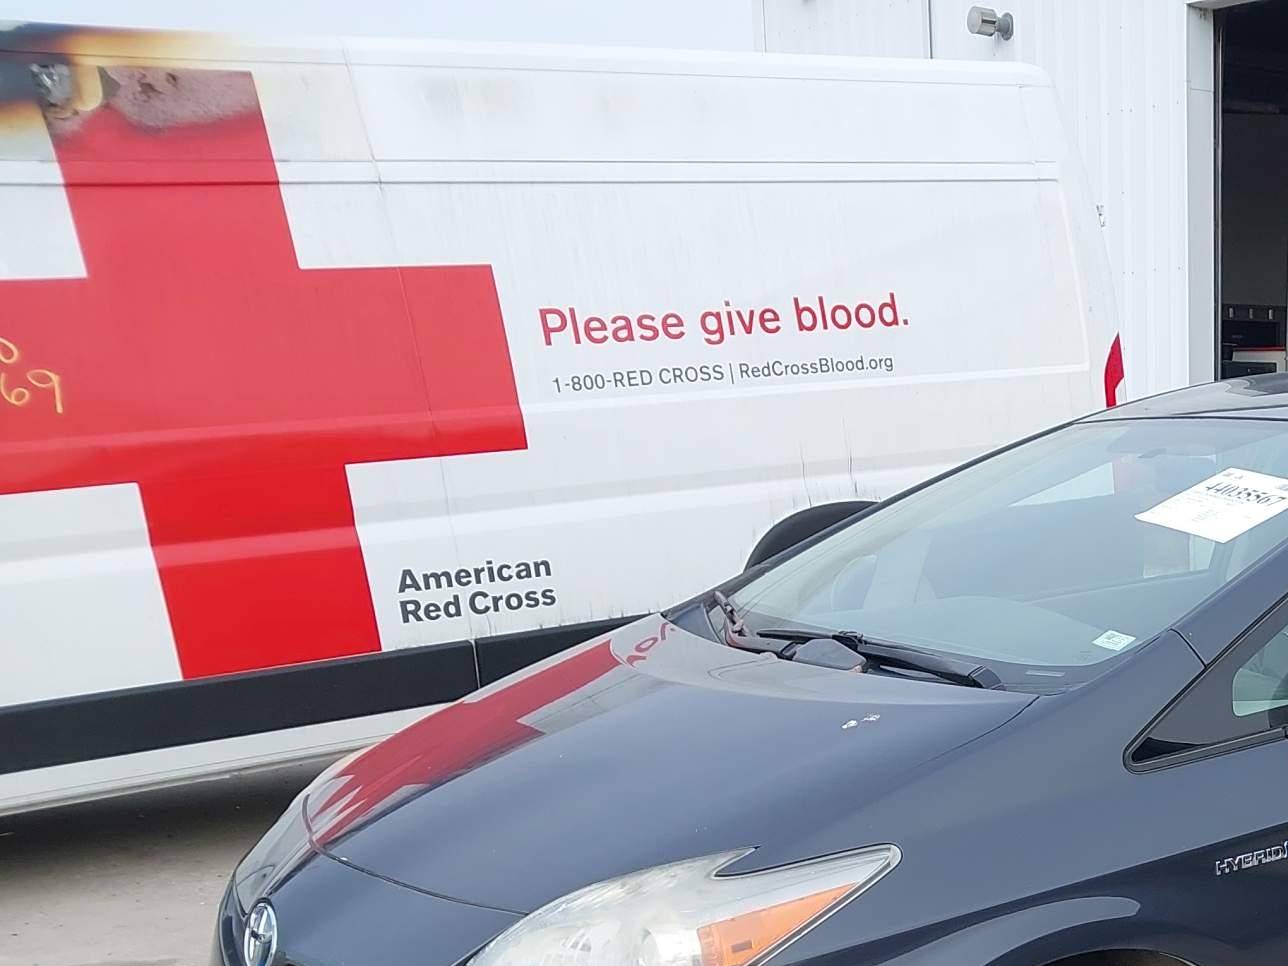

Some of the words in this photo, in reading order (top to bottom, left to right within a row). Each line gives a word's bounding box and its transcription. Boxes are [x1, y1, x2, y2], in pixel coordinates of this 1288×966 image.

[539, 307, 686, 346] Please
[700, 301, 781, 345] give
[793, 293, 909, 332] blood.
[552, 370, 653, 393] 1-800-RED
[659, 365, 724, 384] CROSS
[739, 355, 894, 379] RedCrossBlood.org
[398, 559, 552, 593] American
[400, 594, 462, 624] Red
[469, 588, 557, 615] Cross
[1215, 846, 1285, 875] HYBRID
